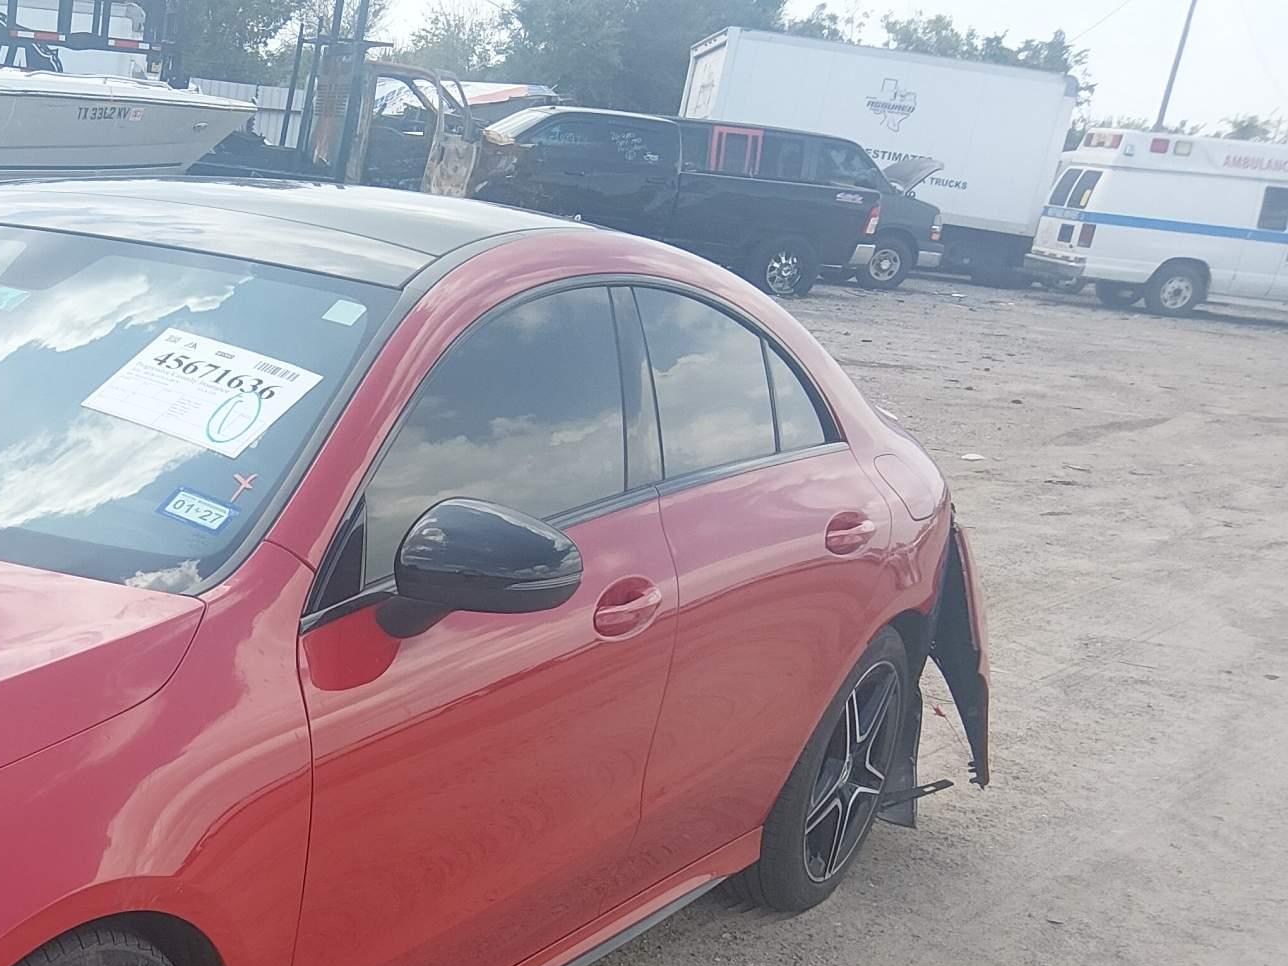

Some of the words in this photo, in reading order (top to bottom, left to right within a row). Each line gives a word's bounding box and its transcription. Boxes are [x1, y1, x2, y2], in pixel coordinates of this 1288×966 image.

[865, 148, 933, 161] STIMA
[930, 177, 968, 190] TRUCKS
[153, 351, 284, 401] 45671636
